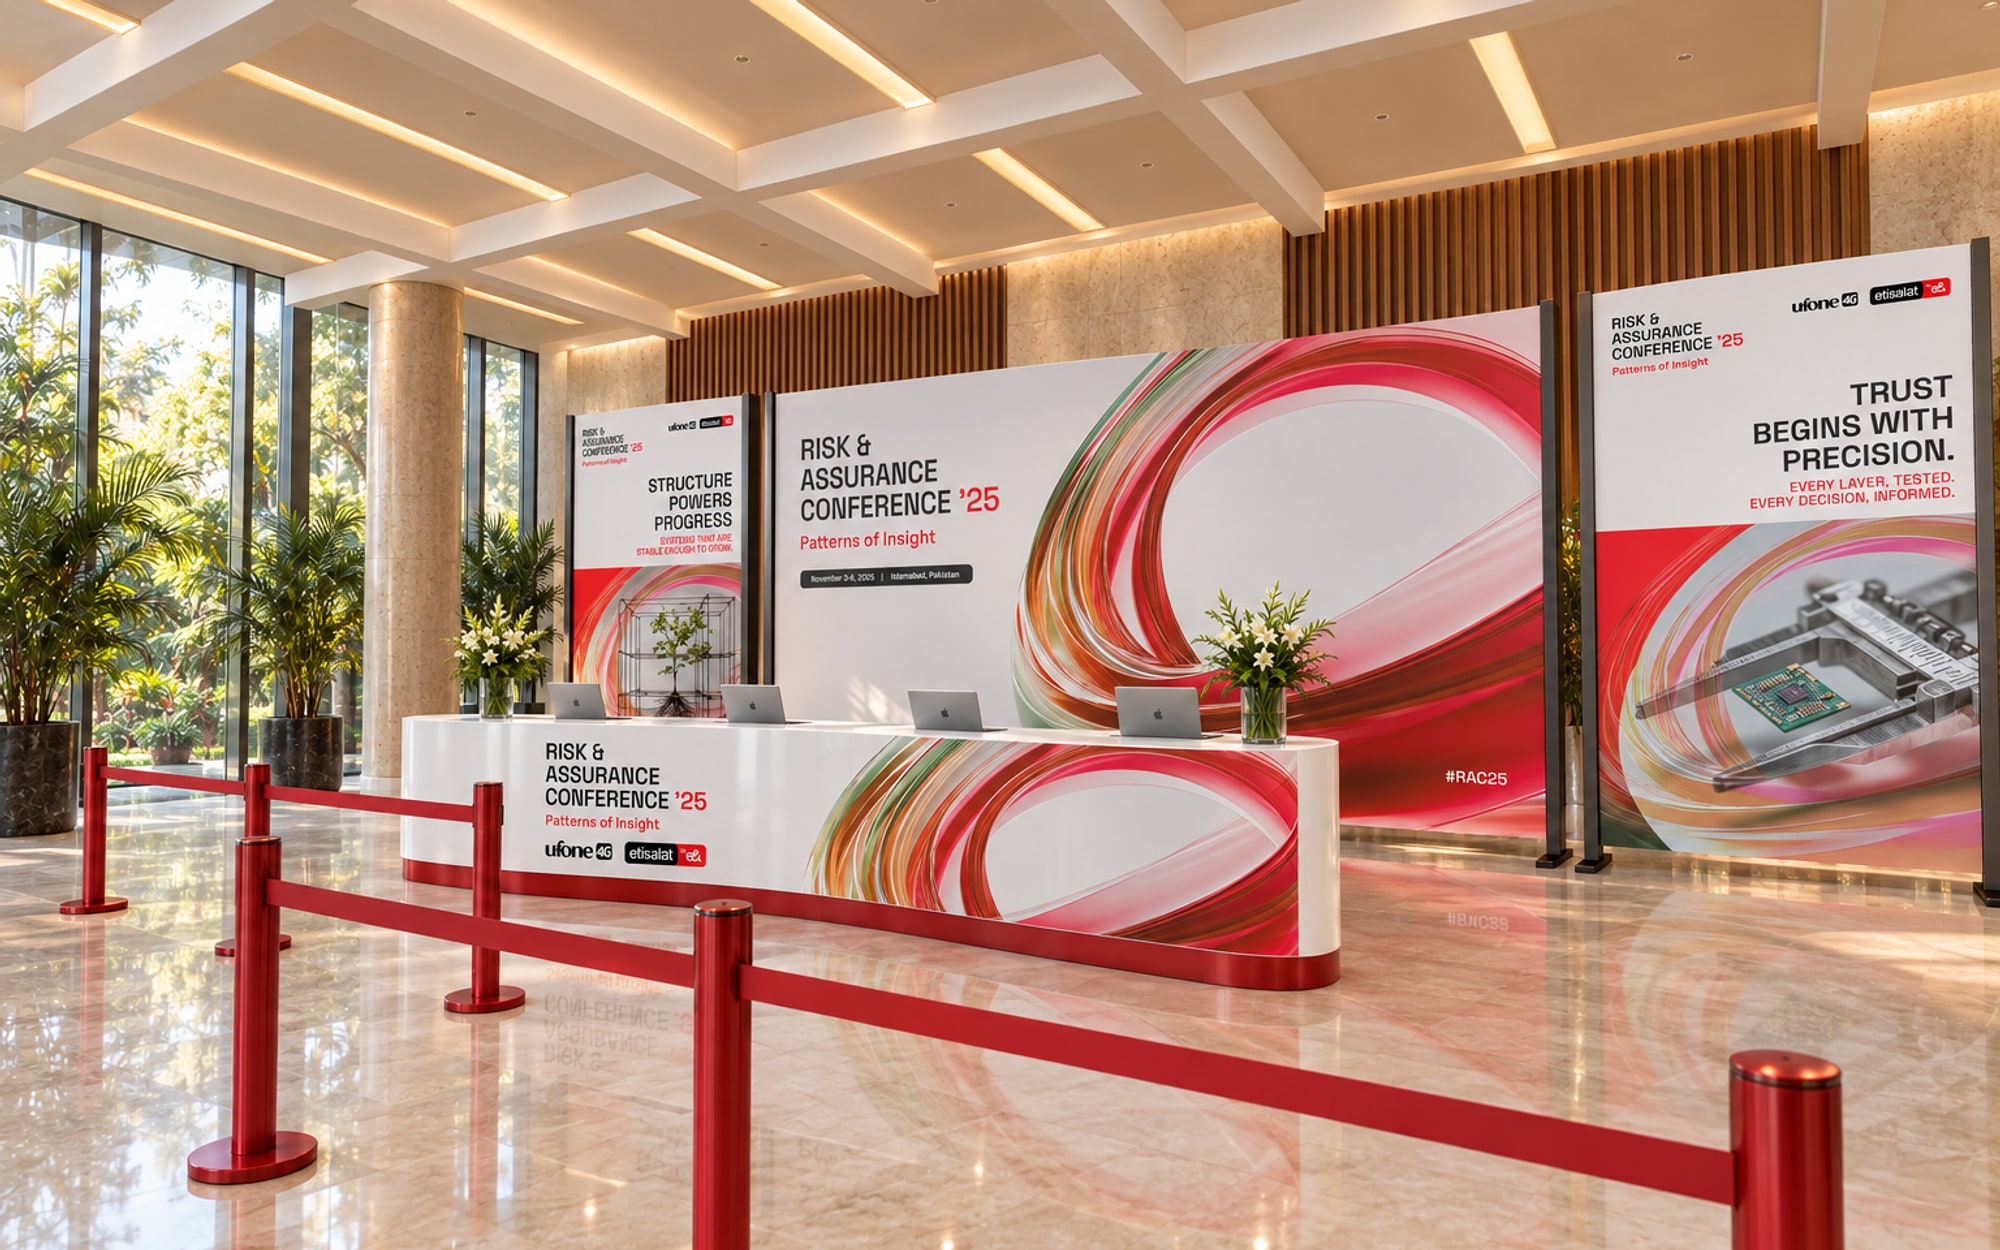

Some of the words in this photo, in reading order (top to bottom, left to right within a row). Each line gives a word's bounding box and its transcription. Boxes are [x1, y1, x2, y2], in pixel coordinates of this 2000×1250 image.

[1792, 297, 1839, 313] ufone
[1842, 294, 1857, 305] 4G
[1874, 286, 1919, 301] etisalat
[1612, 314, 1645, 330] RISK
[1650, 312, 1660, 325] &
[1612, 322, 1703, 345] ASSURANCE
[1612, 336, 1713, 360] CONFERENCE
[1612, 364, 1656, 376] Patterns
[1658, 361, 1669, 371] of
[1672, 357, 1709, 370] Insight
[1850, 375, 1953, 405] TRUST
[1753, 414, 1861, 444] BEGINS
[1870, 406, 1953, 434] WITH
[801, 435, 851, 461] RISK
[857, 434, 871, 456] &
[1783, 438, 1954, 472] PRECISION.
[648, 472, 733, 493] STRUCTURE
[800, 459, 938, 491] ASSURANCE
[1790, 479, 1835, 493] EVERY
[1893, 471, 1955, 486] TESTED.
[669, 491, 732, 511] POWERS
[801, 490, 951, 521] CONFERENCE
[1750, 496, 1794, 509] EVERY
[1873, 486, 1956, 503] INFORMED.
[655, 511, 732, 531] PROGRESS
[800, 535, 860, 550] Patterns
[864, 532, 880, 547] of
[883, 529, 936, 549] Insight
[546, 743, 587, 761] RISK
[592, 743, 604, 761] &
[545, 765, 660, 785] ASSURANCE
[1445, 770, 1508, 786] #RAC25
[545, 788, 669, 809] CONFERENCE
[545, 814, 597, 828] Patterns
[600, 816, 613, 829] of
[616, 817, 660, 833] Insight
[545, 840, 593, 859] ufone
[597, 845, 612, 859] 4G
[629, 847, 674, 862] etisalat
